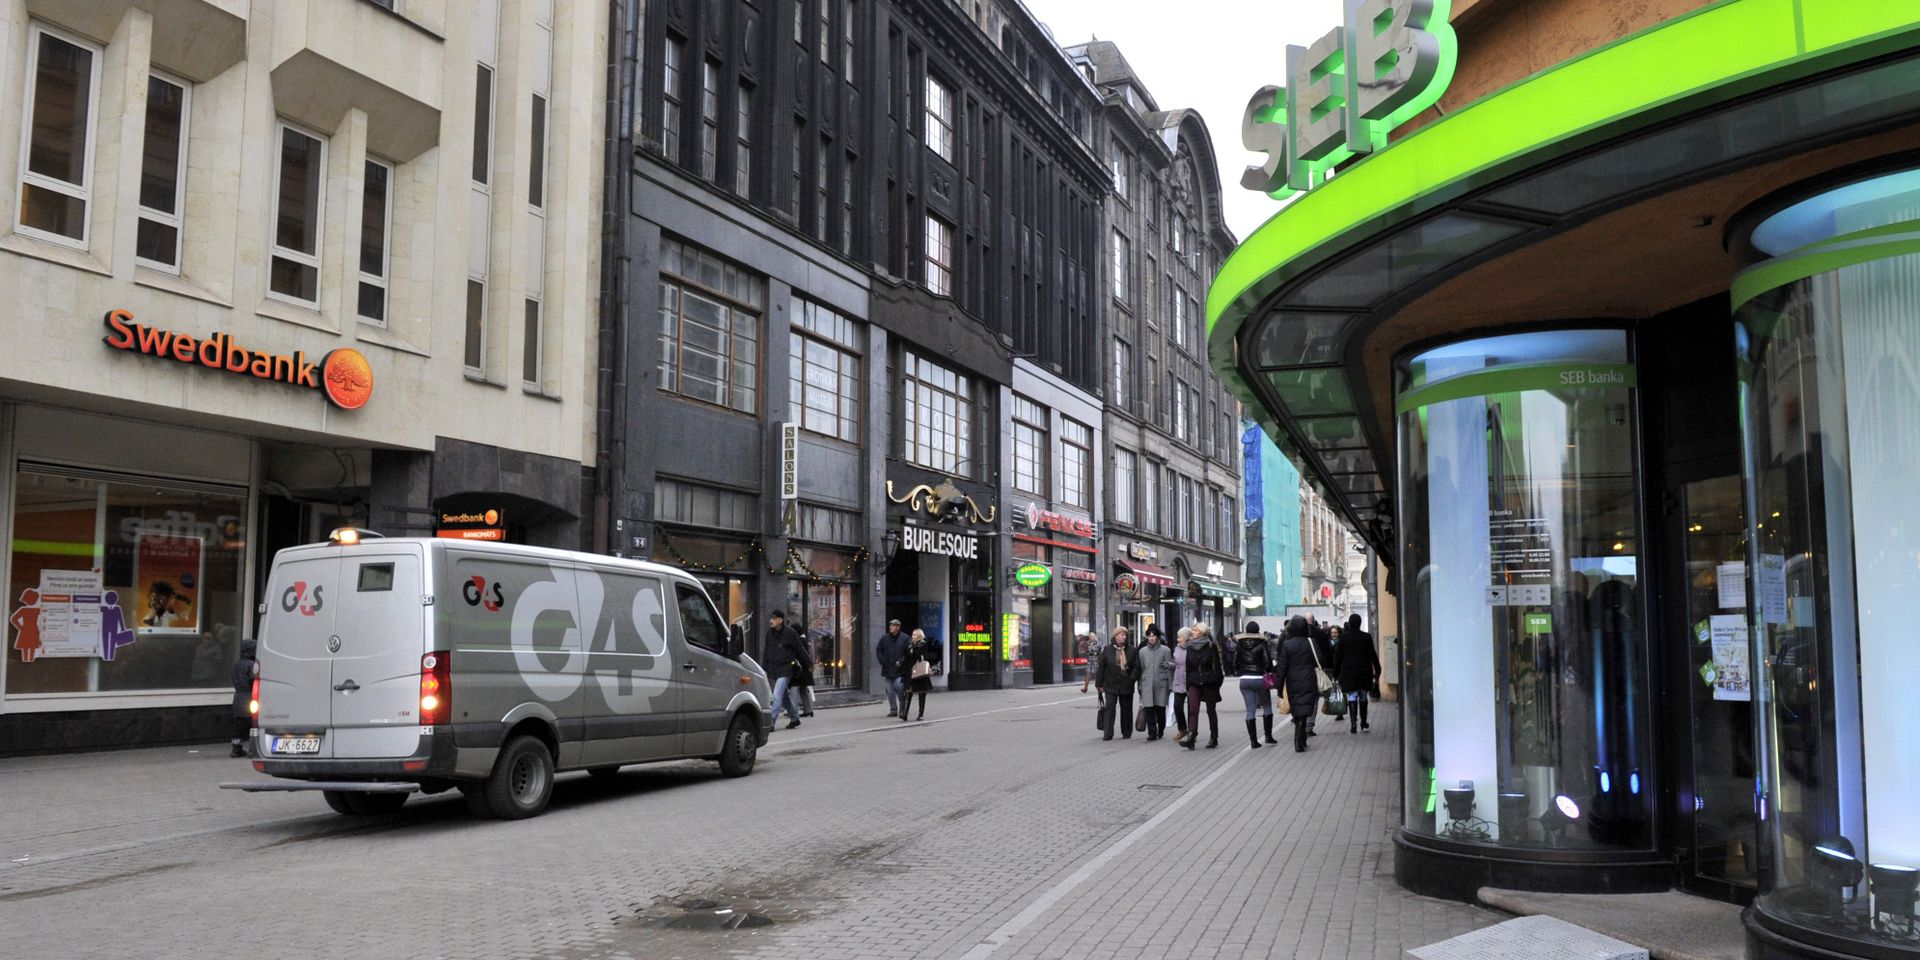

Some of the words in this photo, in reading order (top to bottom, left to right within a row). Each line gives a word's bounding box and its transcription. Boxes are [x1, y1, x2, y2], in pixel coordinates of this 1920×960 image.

[1241, 0, 1446, 196] SEB
[104, 308, 318, 388] Swedbank
[1559, 370, 1585, 385] SEB
[1588, 369, 1624, 384] banka
[785, 427, 794, 496] SALONS
[442, 512, 485, 524] Swedbank
[903, 525, 979, 560] BURLESQUE
[281, 581, 324, 617] G4S
[463, 575, 505, 612] G4S
[278, 739, 319, 751] JK-6627
